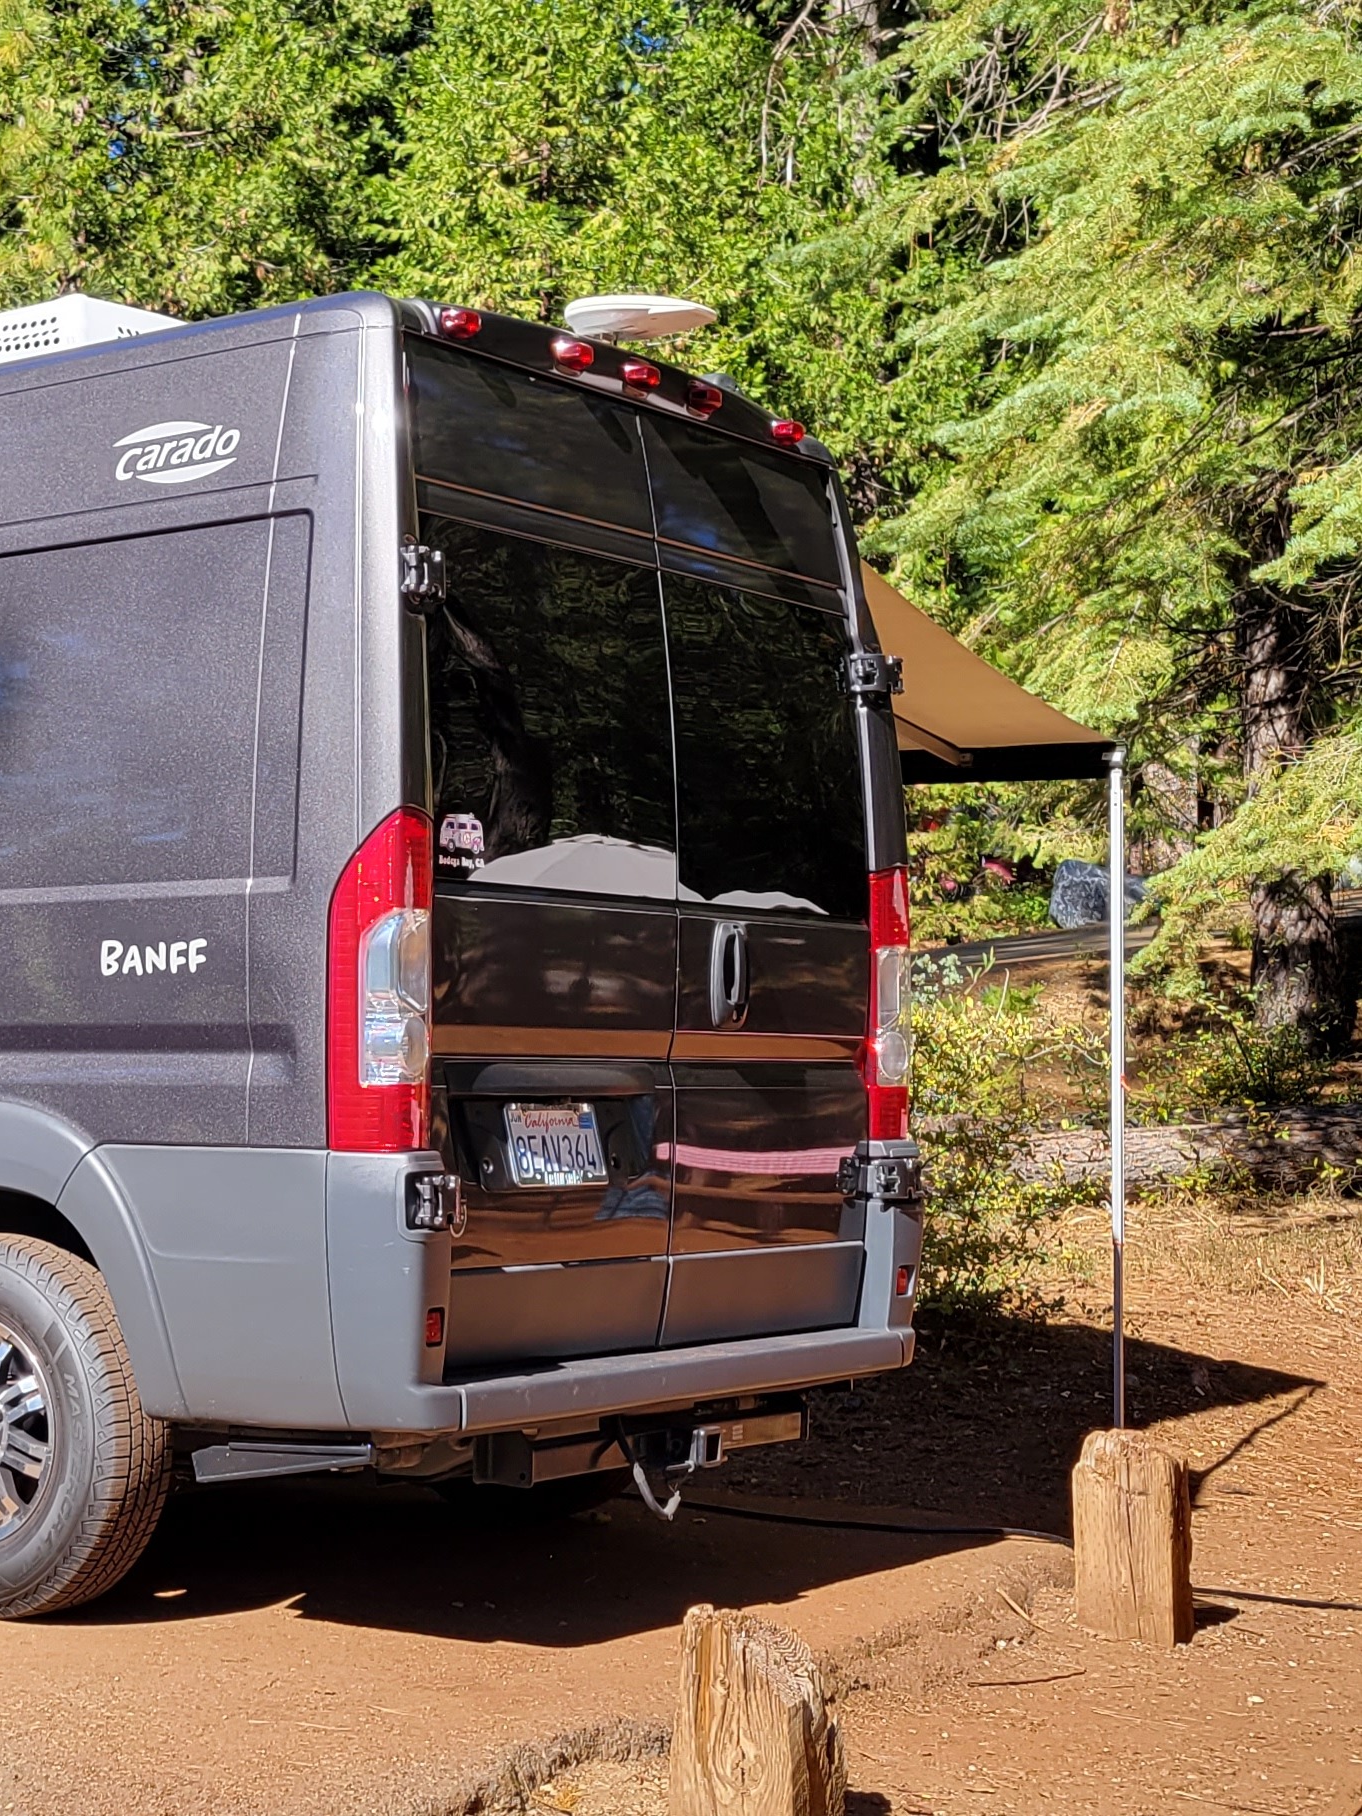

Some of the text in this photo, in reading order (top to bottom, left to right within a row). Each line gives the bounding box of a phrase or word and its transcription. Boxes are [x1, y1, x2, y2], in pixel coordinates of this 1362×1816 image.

[100, 937, 208, 977] BANFF
[524, 1112, 580, 1133] California
[516, 1133, 598, 1173] 8EAV364
